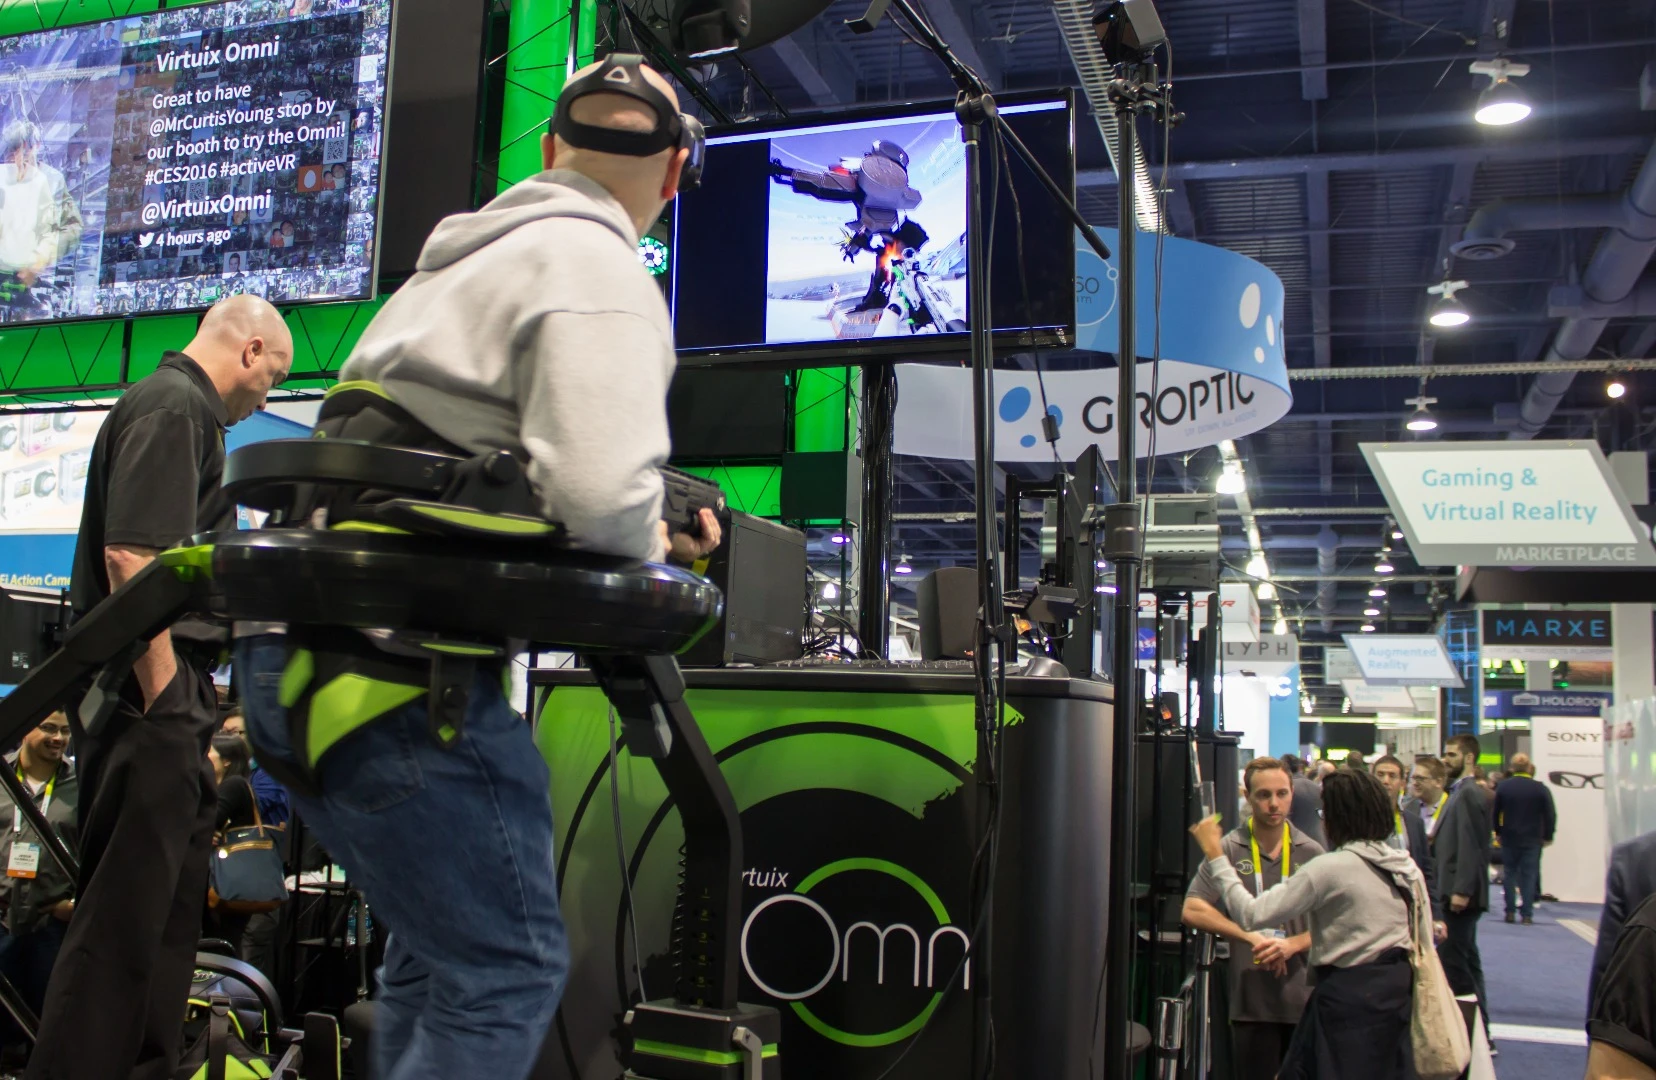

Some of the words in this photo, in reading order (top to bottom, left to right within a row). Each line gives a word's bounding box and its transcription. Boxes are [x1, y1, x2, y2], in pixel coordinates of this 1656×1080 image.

[157, 46, 220, 72] Virtuix
[225, 35, 280, 62] Omni
[153, 93, 192, 109] Great
[196, 88, 211, 102] to
[215, 84, 251, 101] have
[150, 106, 274, 137] @MrCurtisYoung
[277, 102, 312, 119] stop
[316, 97, 336, 117] by
[147, 147, 173, 161] our
[176, 136, 220, 157] booth
[224, 136, 239, 151] to
[243, 133, 265, 151] try
[268, 128, 294, 146] the
[297, 121, 346, 142] Omni!
[145, 163, 217, 186] #CES2016
[220, 154, 296, 177] #activeVR
[141, 189, 272, 225] @VirtuixOmni
[156, 235, 165, 247] 4
[167, 231, 204, 247] hours
[207, 229, 231, 246] ago
[1082, 371, 1255, 435] GROPTIC
[1422, 467, 1514, 491] Gaming
[1521, 468, 1538, 487] &
[1422, 501, 1505, 521] Virtual
[1512, 500, 1598, 525] Reality
[1496, 547, 1637, 562] MARKETPLACE
[10, 573, 42, 587] Action
[1227, 641, 1289, 656] LYPH
[1368, 647, 1438, 658] Augmented
[1368, 660, 1410, 671] Reality
[1548, 732, 1601, 743] SONY
[742, 867, 789, 888] rtuix
[740, 893, 970, 1000] Omn
